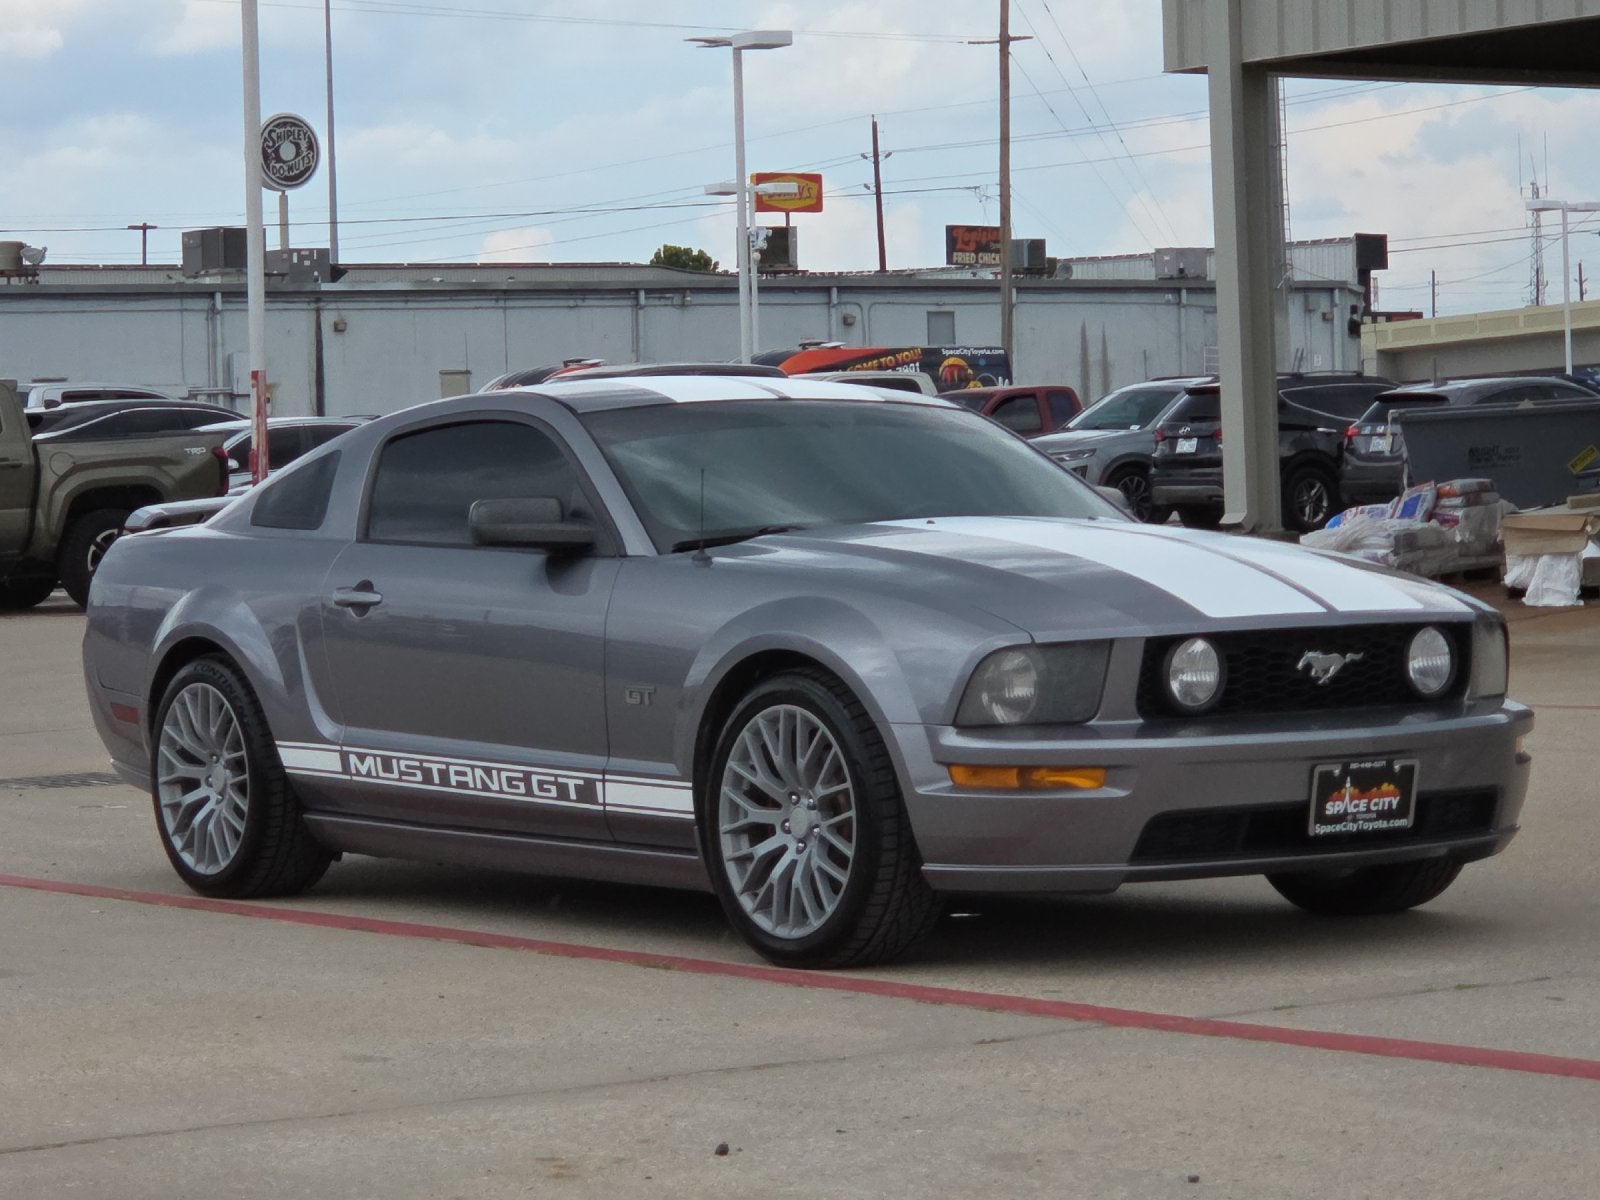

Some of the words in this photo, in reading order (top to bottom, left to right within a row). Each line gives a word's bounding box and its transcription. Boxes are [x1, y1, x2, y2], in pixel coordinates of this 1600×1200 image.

[265, 128, 309, 149] SHIPLEY
[953, 252, 977, 264] FRIED
[978, 253, 1000, 264] CHICK
[880, 355, 895, 367] TO
[184, 447, 207, 455] TRD
[624, 685, 655, 705] GT
[348, 753, 527, 795] MUSTANG
[530, 773, 585, 801] GT
[1325, 798, 1369, 815] SPACE
[1370, 796, 1400, 811] CITY
[1315, 818, 1408, 835] SpaceCityToyota.com
